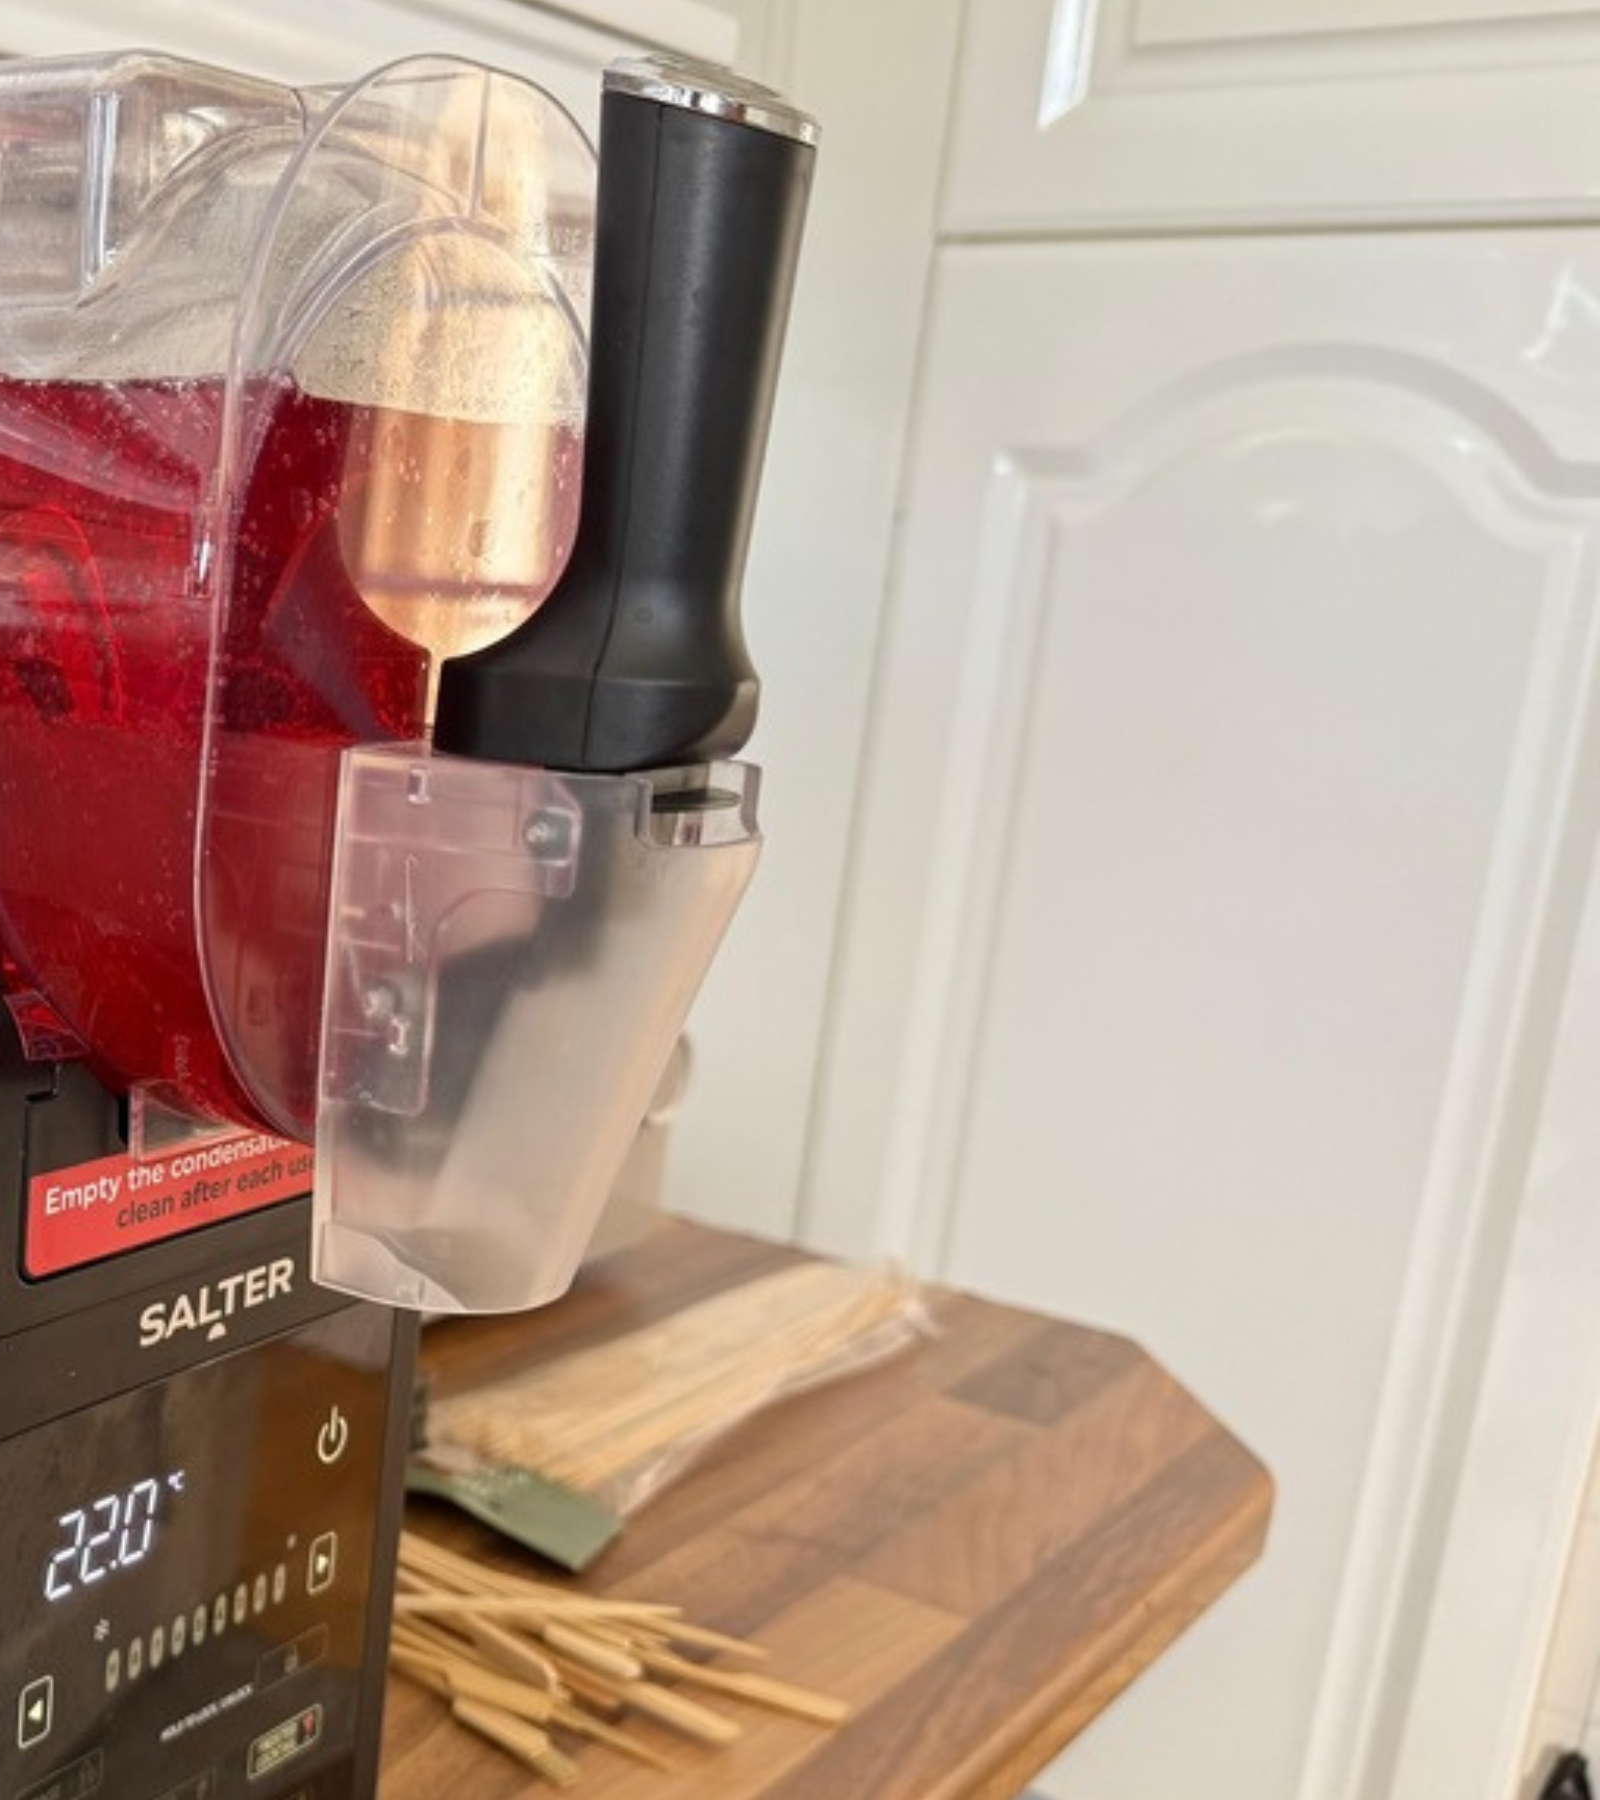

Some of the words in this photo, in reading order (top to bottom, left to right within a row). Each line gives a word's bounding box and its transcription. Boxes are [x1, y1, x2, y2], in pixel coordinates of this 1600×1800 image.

[45, 1175, 123, 1215] Empty
[127, 1161, 165, 1193] the
[117, 1194, 175, 1229] clean
[181, 1179, 232, 1210] after
[237, 1159, 282, 1193] each
[139, 1257, 295, 1347] SALTER
[44, 1478, 158, 1602] 22.0
